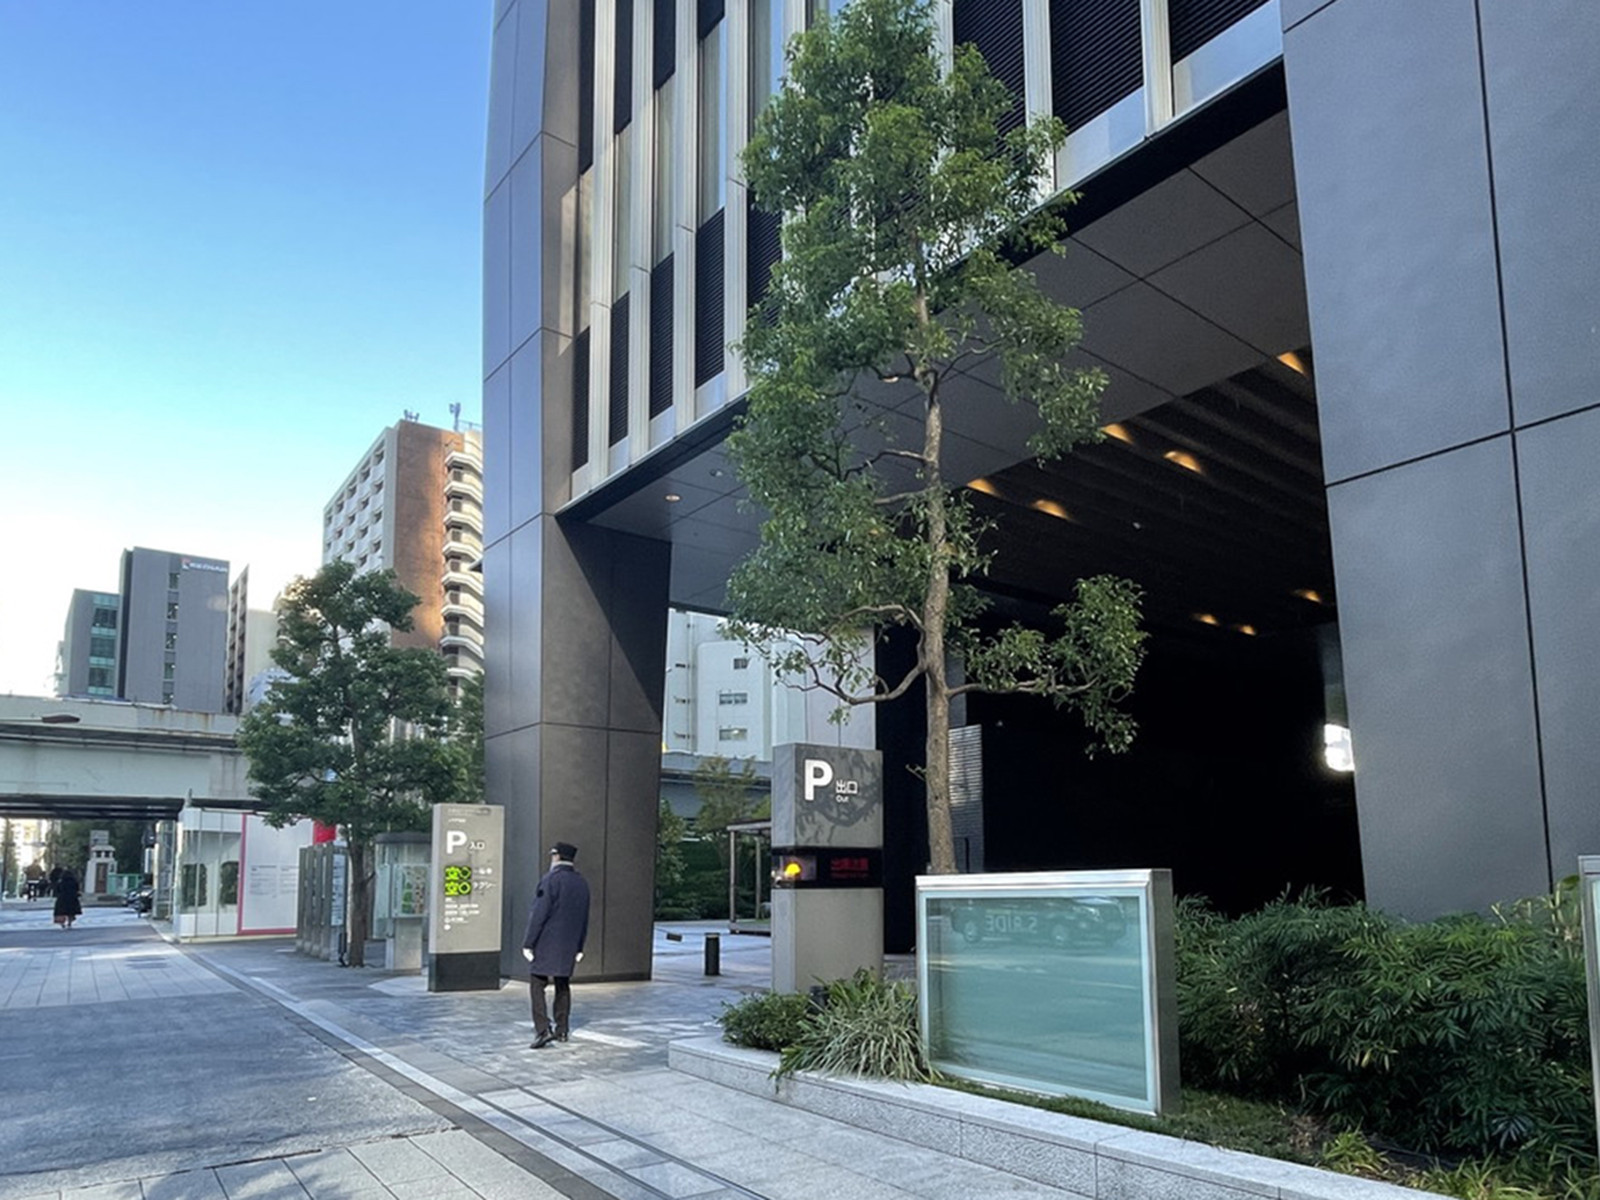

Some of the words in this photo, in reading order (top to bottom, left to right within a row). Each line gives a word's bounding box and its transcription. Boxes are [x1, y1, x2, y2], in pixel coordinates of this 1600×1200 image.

[804, 759, 834, 801] P
[835, 779, 858, 794] 出口
[447, 830, 467, 854] P
[469, 841, 485, 850] 入口
